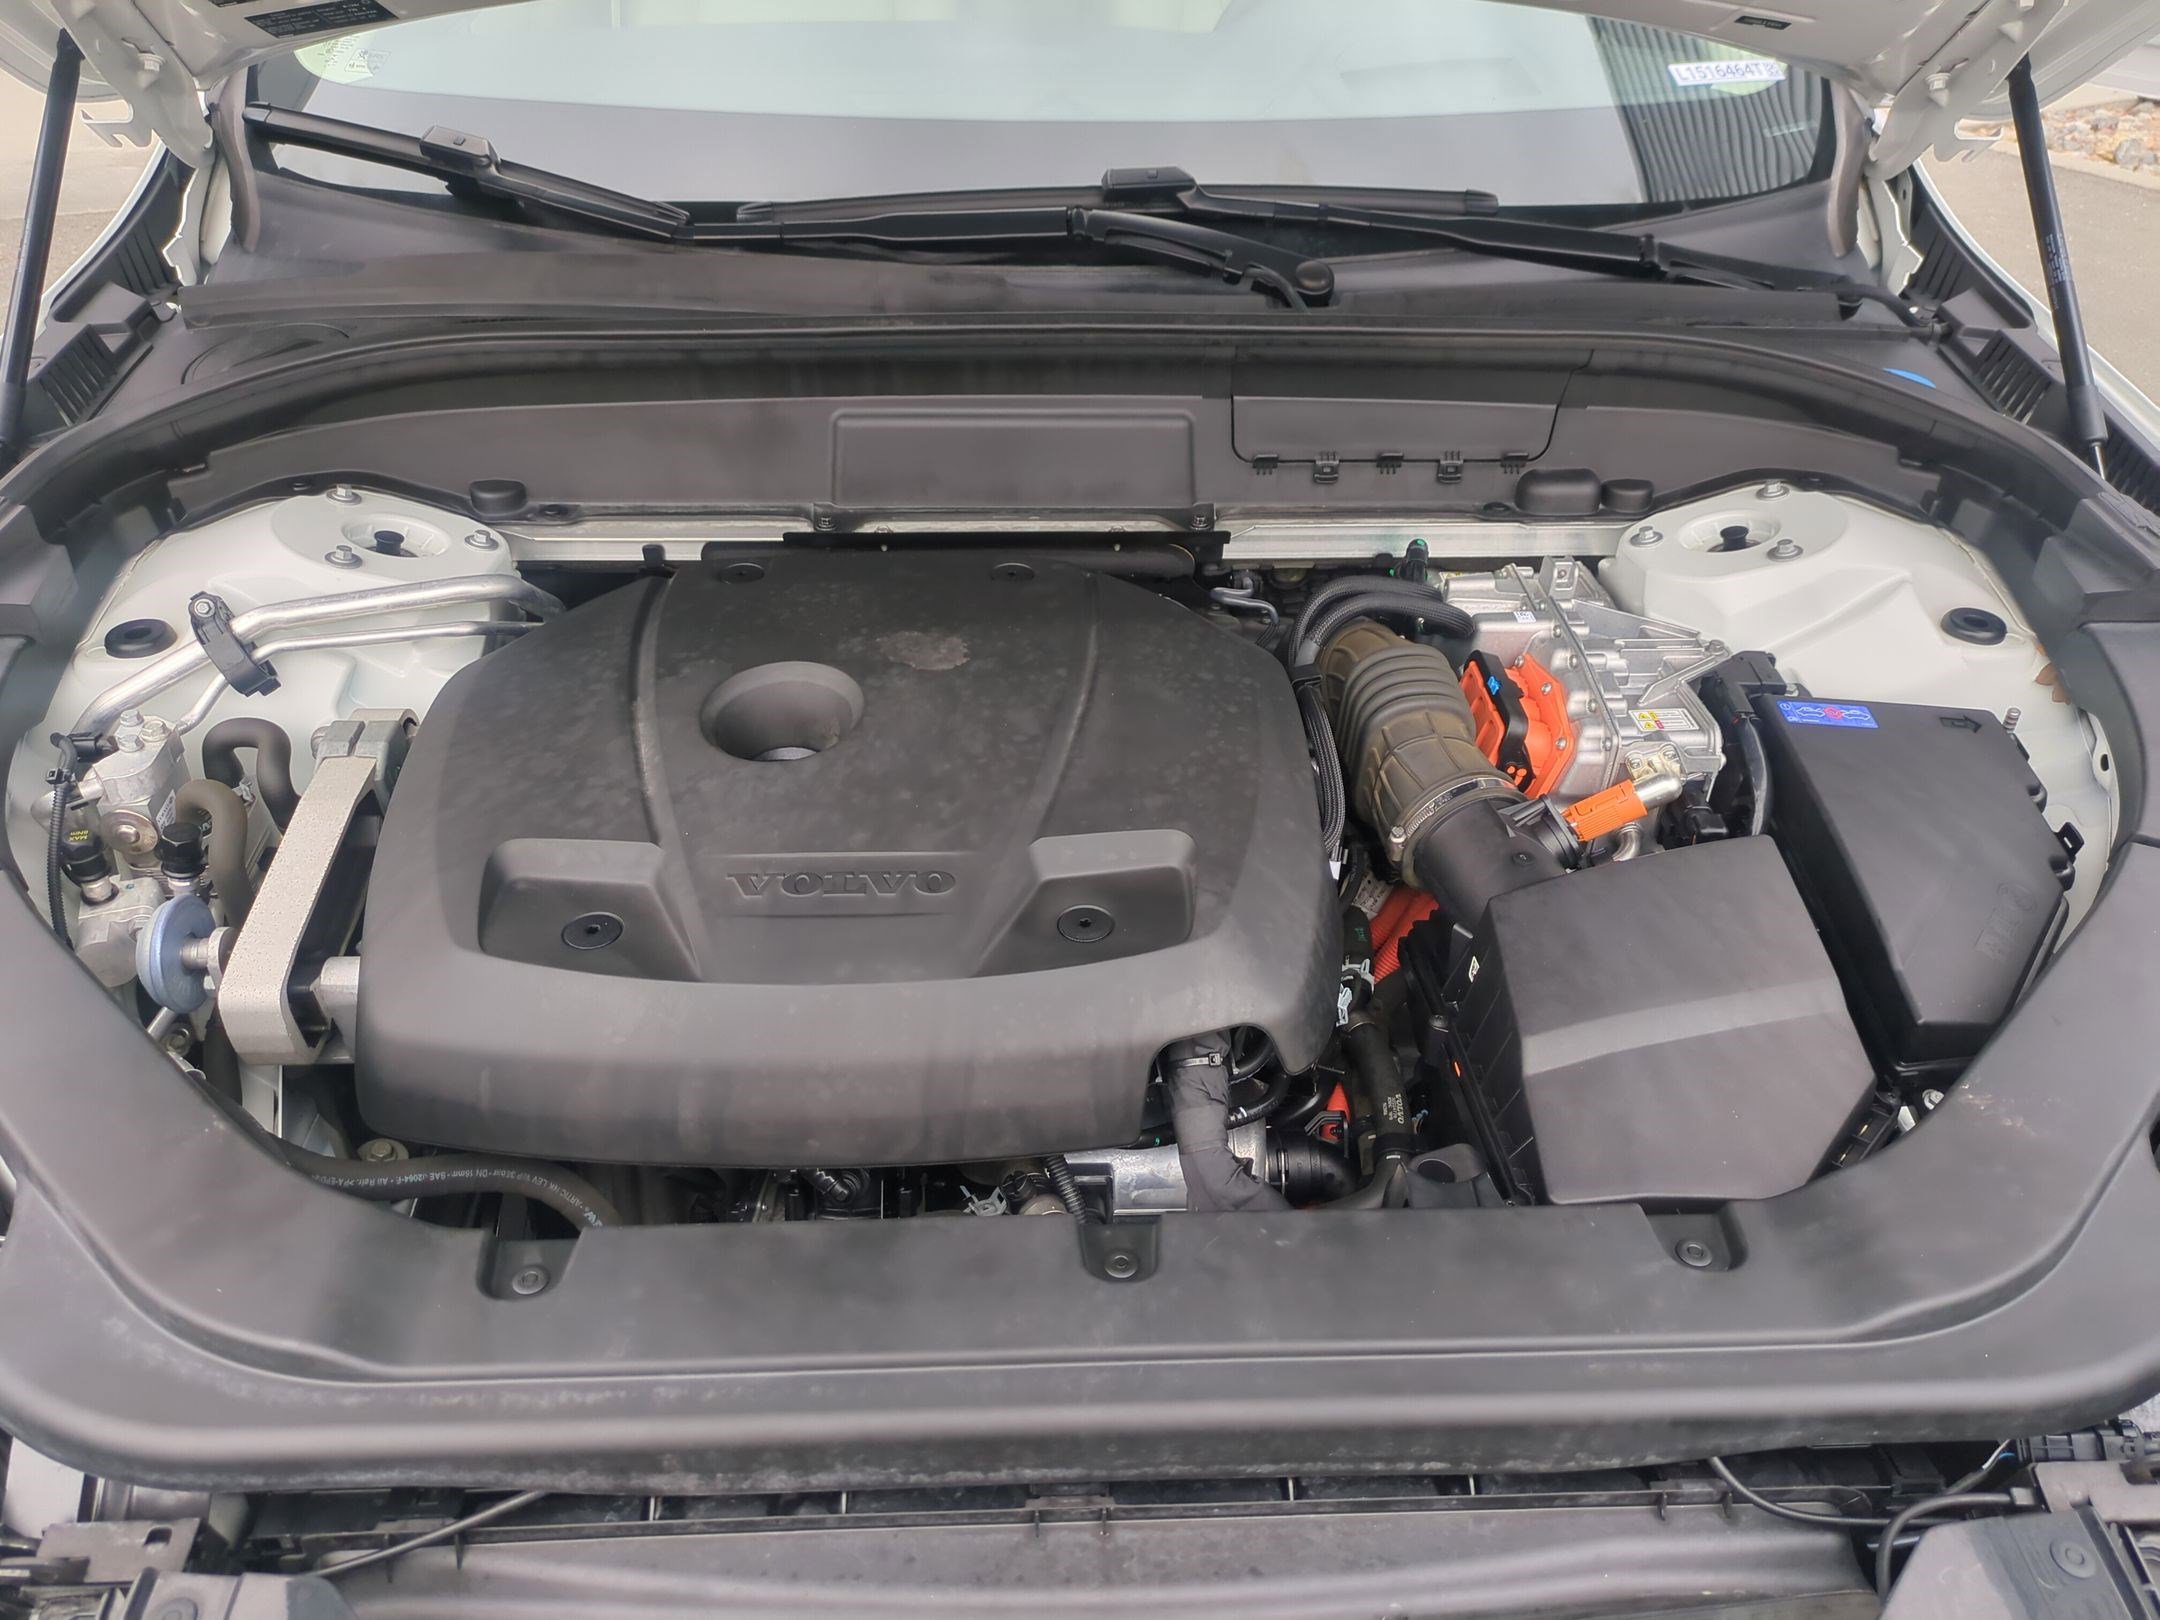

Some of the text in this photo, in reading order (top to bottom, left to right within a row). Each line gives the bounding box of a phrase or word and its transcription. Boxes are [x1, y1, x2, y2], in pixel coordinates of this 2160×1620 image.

[725, 870, 957, 898] VOLVO
[1395, 1093, 1405, 1124] VOLVO
[429, 1171, 447, 1180] SAE
